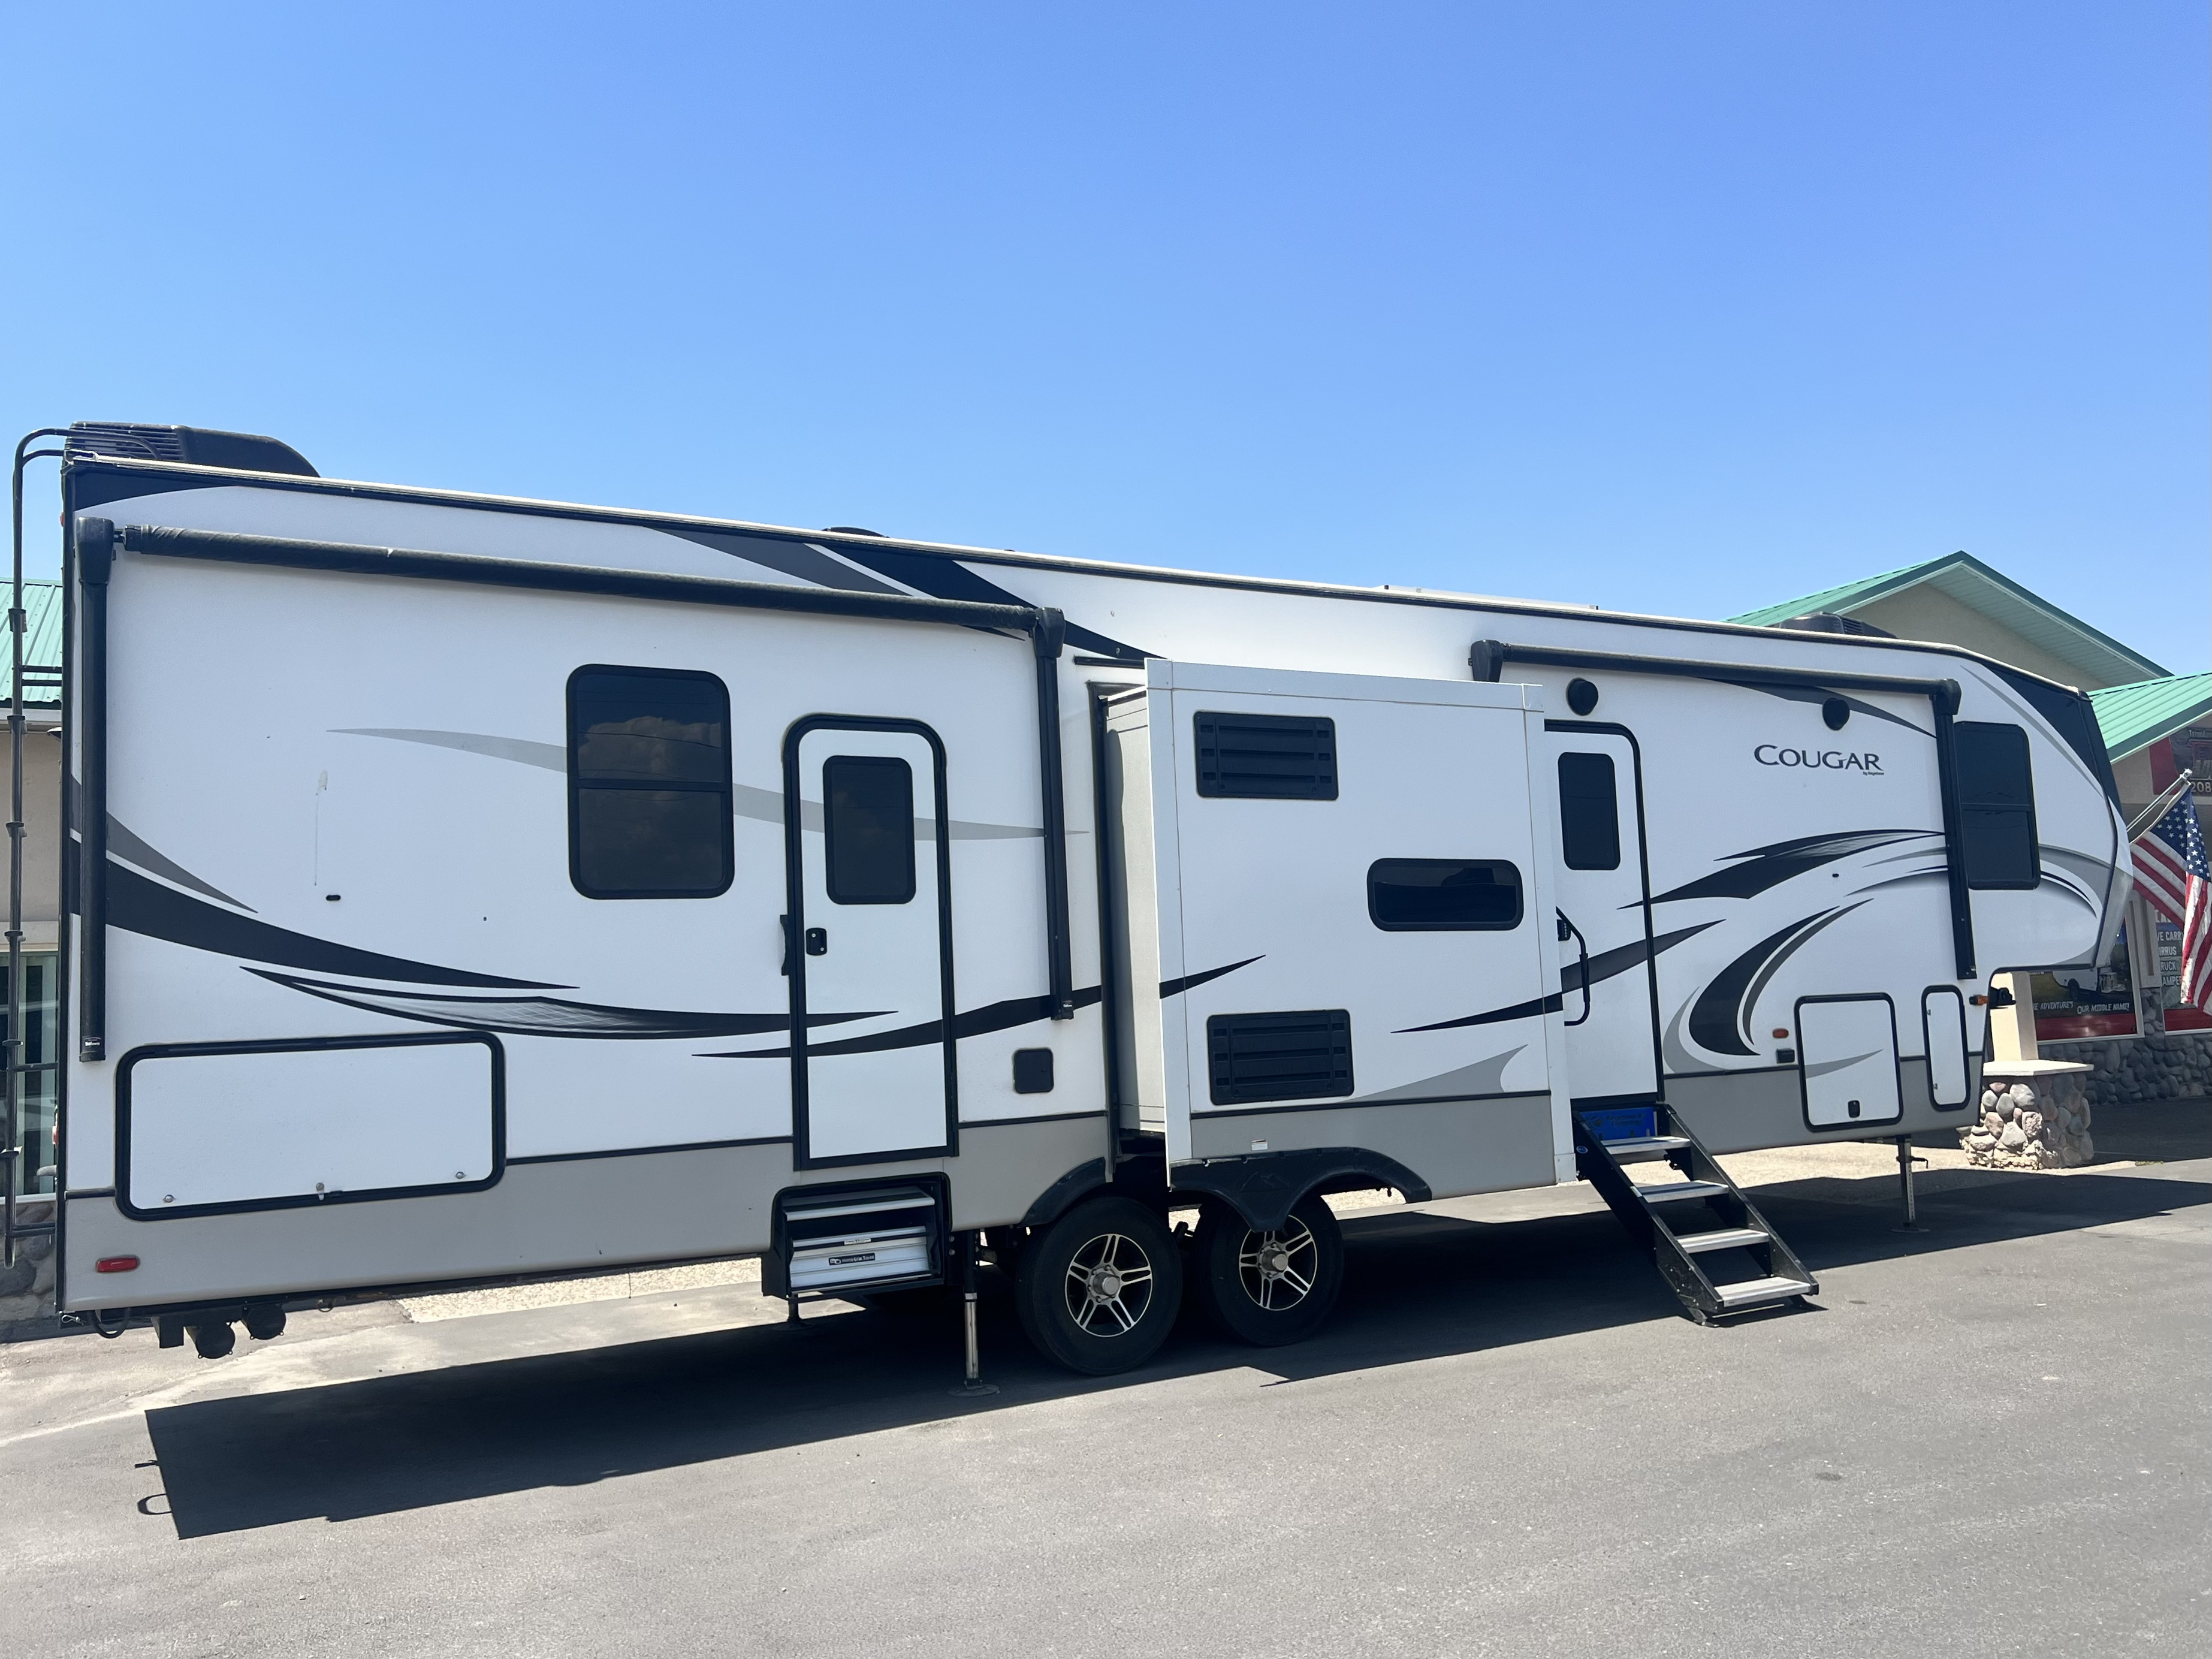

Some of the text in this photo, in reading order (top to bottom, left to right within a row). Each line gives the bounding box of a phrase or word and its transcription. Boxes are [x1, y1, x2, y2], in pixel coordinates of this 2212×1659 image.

[1754, 744, 1884, 771] COUGAR
[2159, 946, 2177, 956] IRRUS
[2160, 961, 2177, 971] RUCK
[2162, 976, 2181, 985] AMPE
